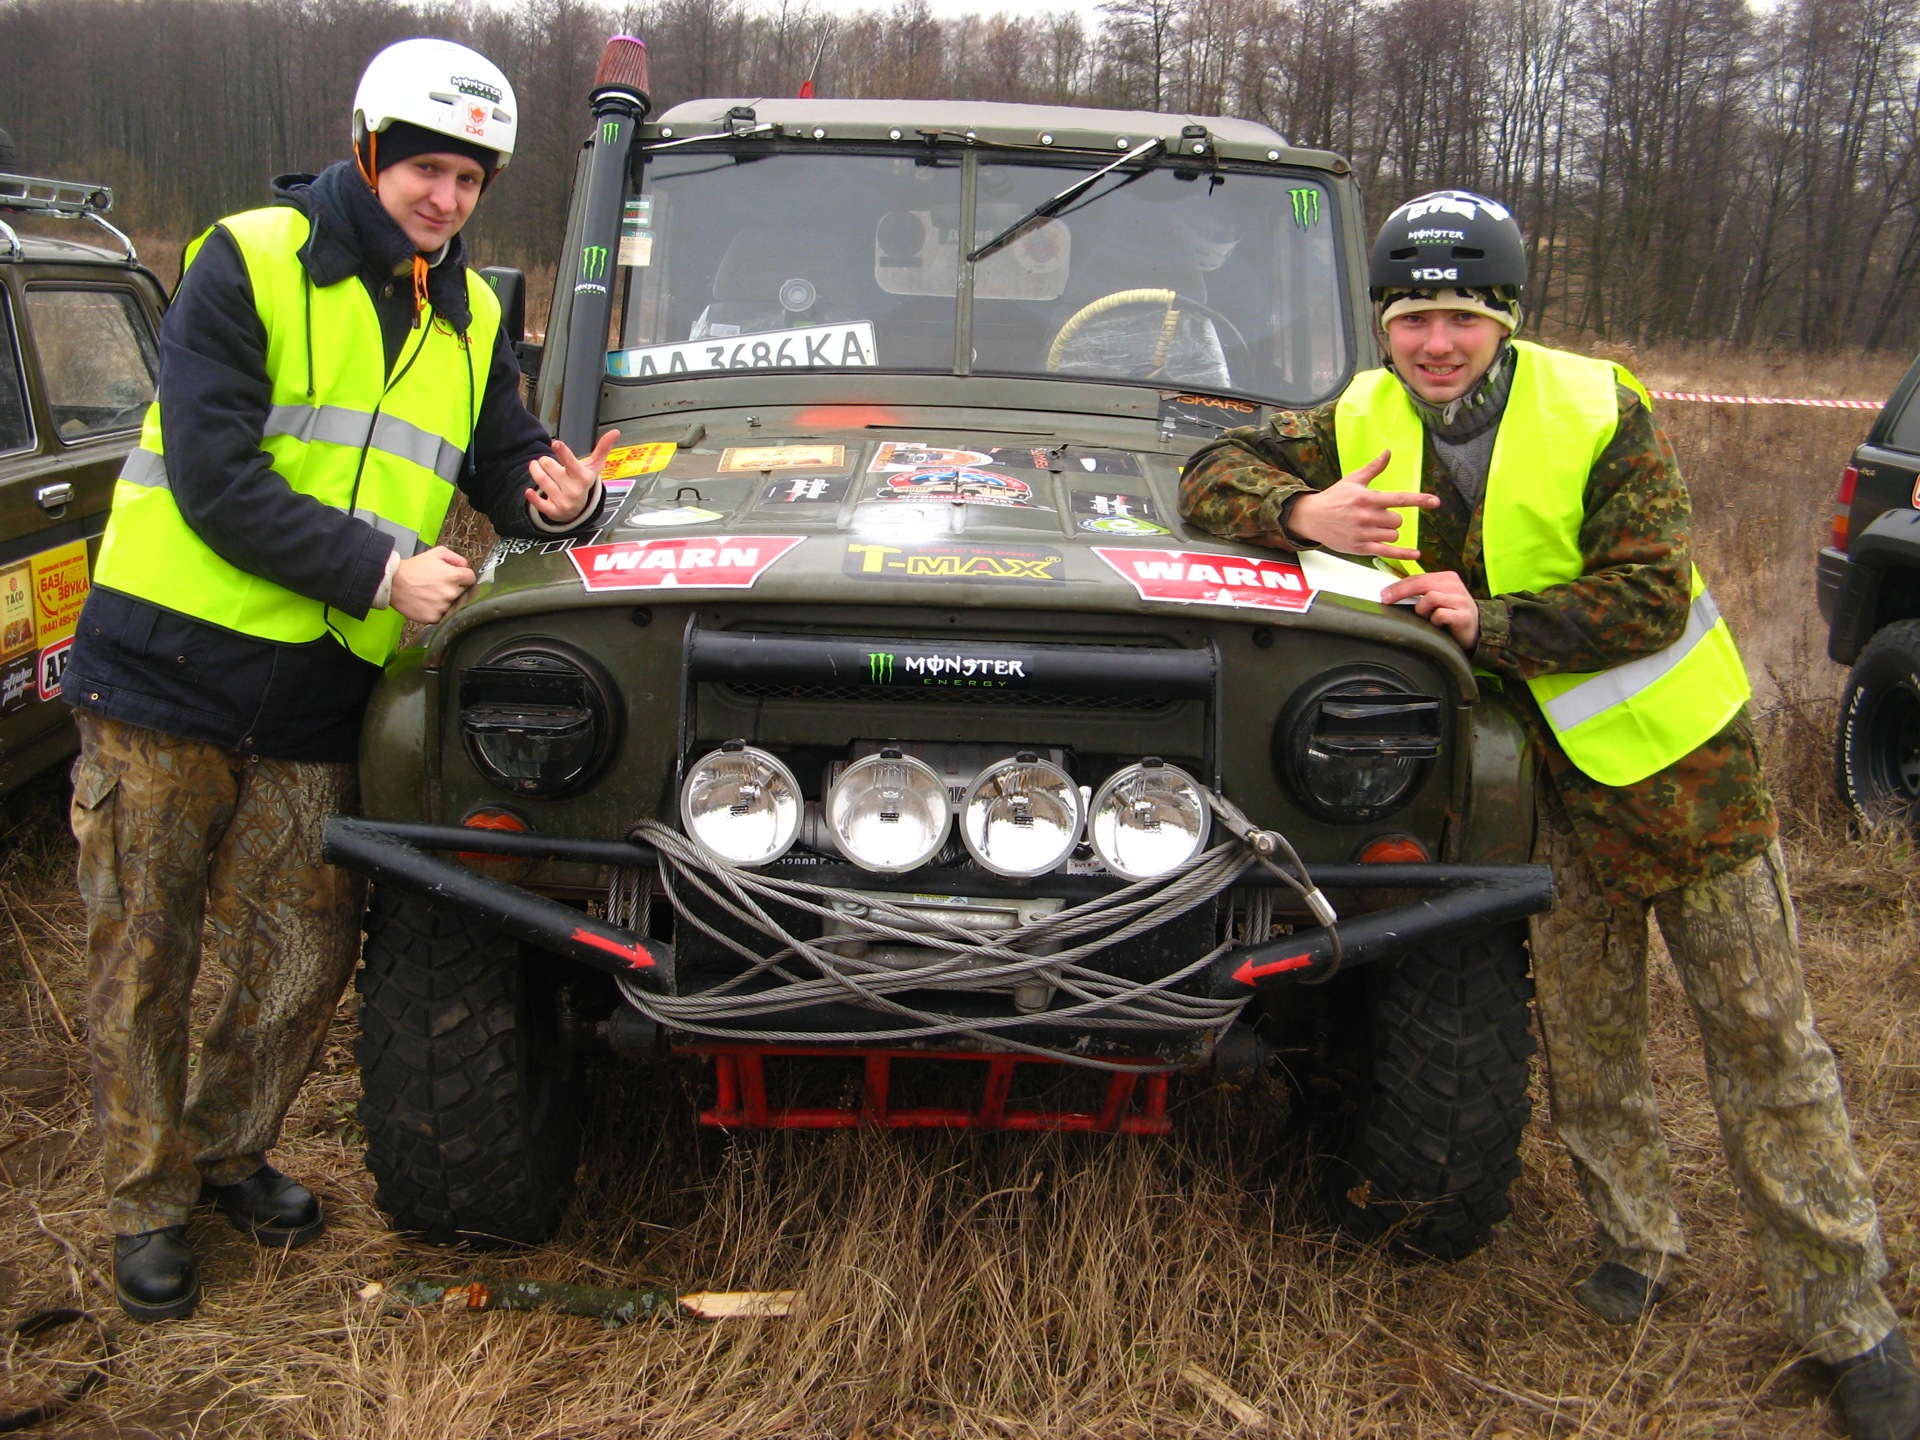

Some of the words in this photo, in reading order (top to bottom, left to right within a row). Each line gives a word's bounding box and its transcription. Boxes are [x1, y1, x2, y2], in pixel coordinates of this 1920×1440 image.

[451, 77, 502, 99] MONSTER
[460, 88, 496, 101] ENERGY
[1408, 229, 1464, 240] MONSTER
[593, 547, 759, 572] WARN
[1132, 561, 1303, 592] WARN
[58, 578, 89, 602] ЗВУКА
[905, 655, 1026, 678] MONSTER
[923, 678, 1007, 687] ENERGY
